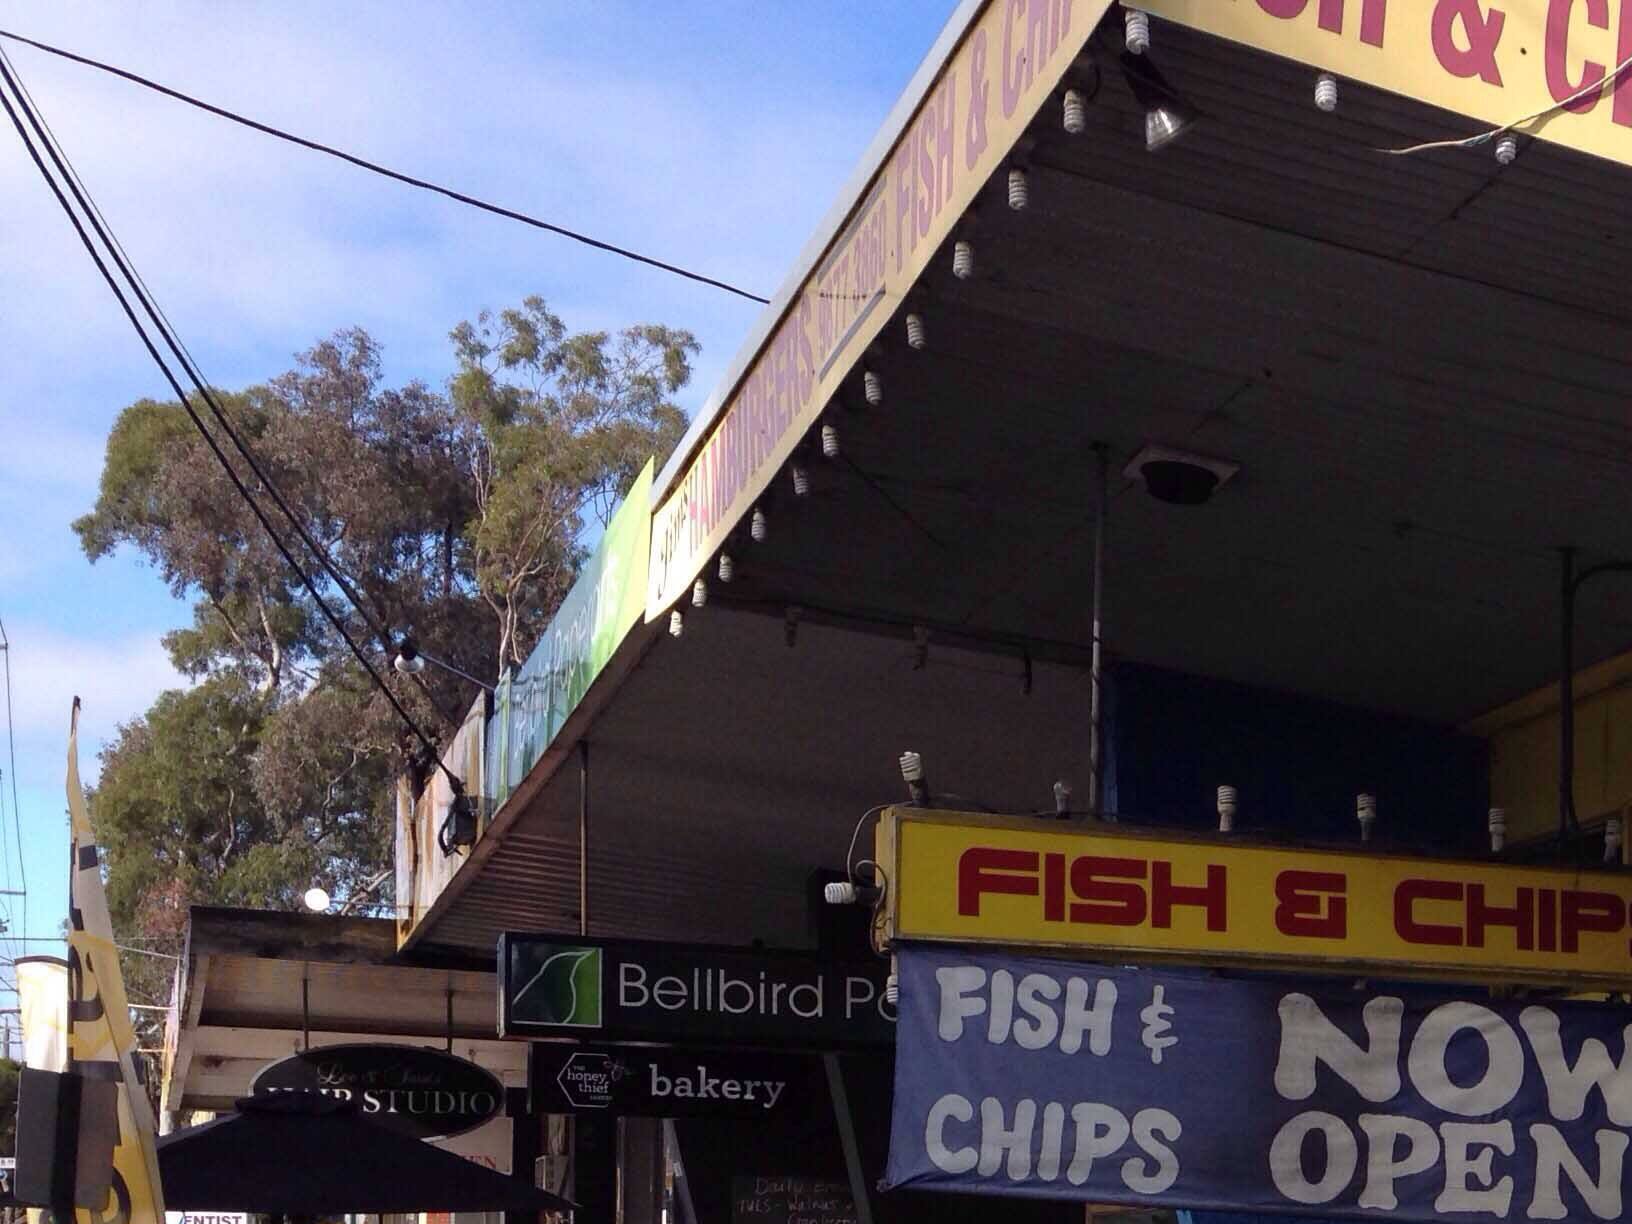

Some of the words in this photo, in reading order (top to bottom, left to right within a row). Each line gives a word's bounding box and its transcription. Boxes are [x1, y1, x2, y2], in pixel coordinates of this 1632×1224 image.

[1430, 0, 1506, 87] &
[688, 288, 816, 558] HAMBURGERS
[894, 72, 957, 274] FISH
[966, 27, 990, 172] &
[957, 846, 1229, 933] FISH
[1274, 869, 1347, 940] &
[619, 962, 824, 1018] Bellbird
[936, 966, 1120, 1058] FISH
[1139, 985, 1180, 1065] &
[362, 1088, 497, 1114] STUDIO
[566, 1066, 608, 1085] honey
[578, 1081, 610, 1094] thief
[649, 1063, 787, 1109] bakery
[924, 1093, 1183, 1196] CHIPS
[1268, 1109, 1631, 1221] OPEN
